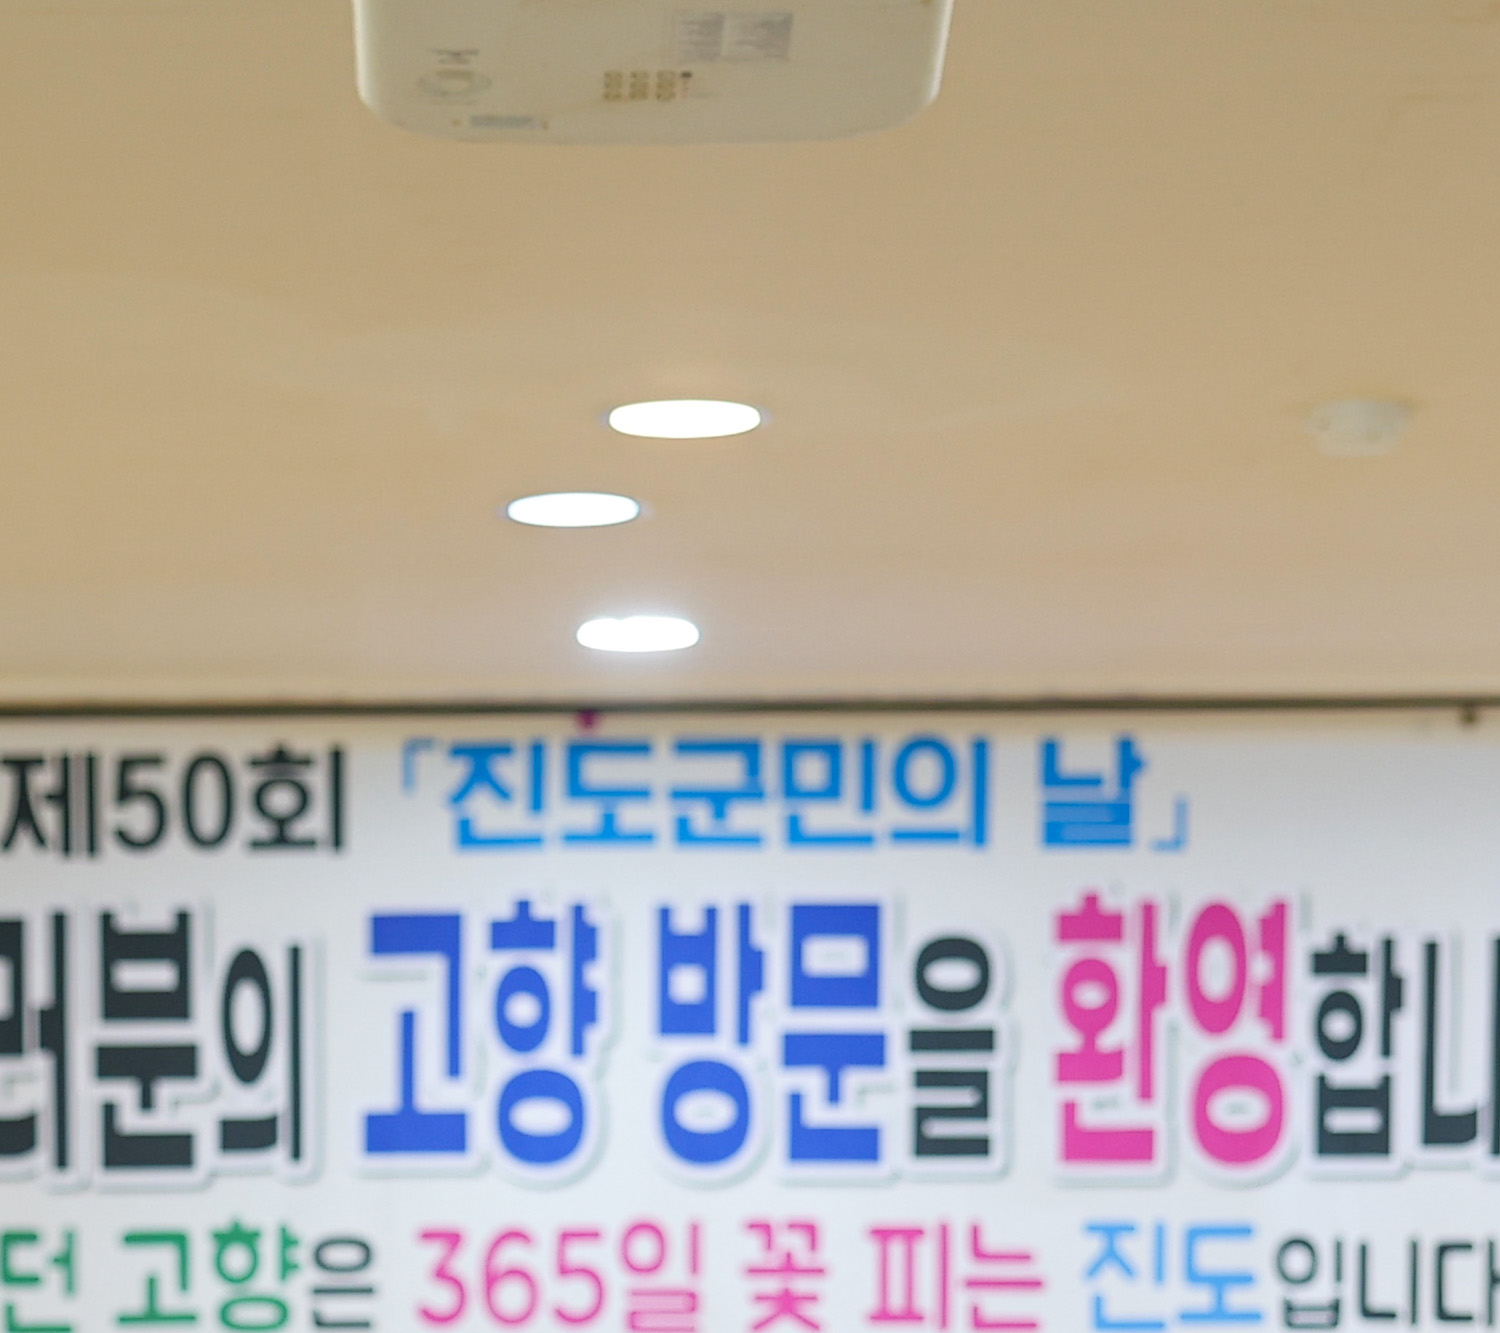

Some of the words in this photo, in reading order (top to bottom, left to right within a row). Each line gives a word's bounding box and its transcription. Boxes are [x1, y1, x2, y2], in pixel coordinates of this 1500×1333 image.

[364, 897, 600, 1165] 고향
[658, 900, 995, 1165] 방문을
[116, 1220, 375, 1333] 고향은
[419, 1220, 698, 1331] 365일
[743, 1222, 826, 1330] 꽃
[868, 1224, 1045, 1330] 피는
